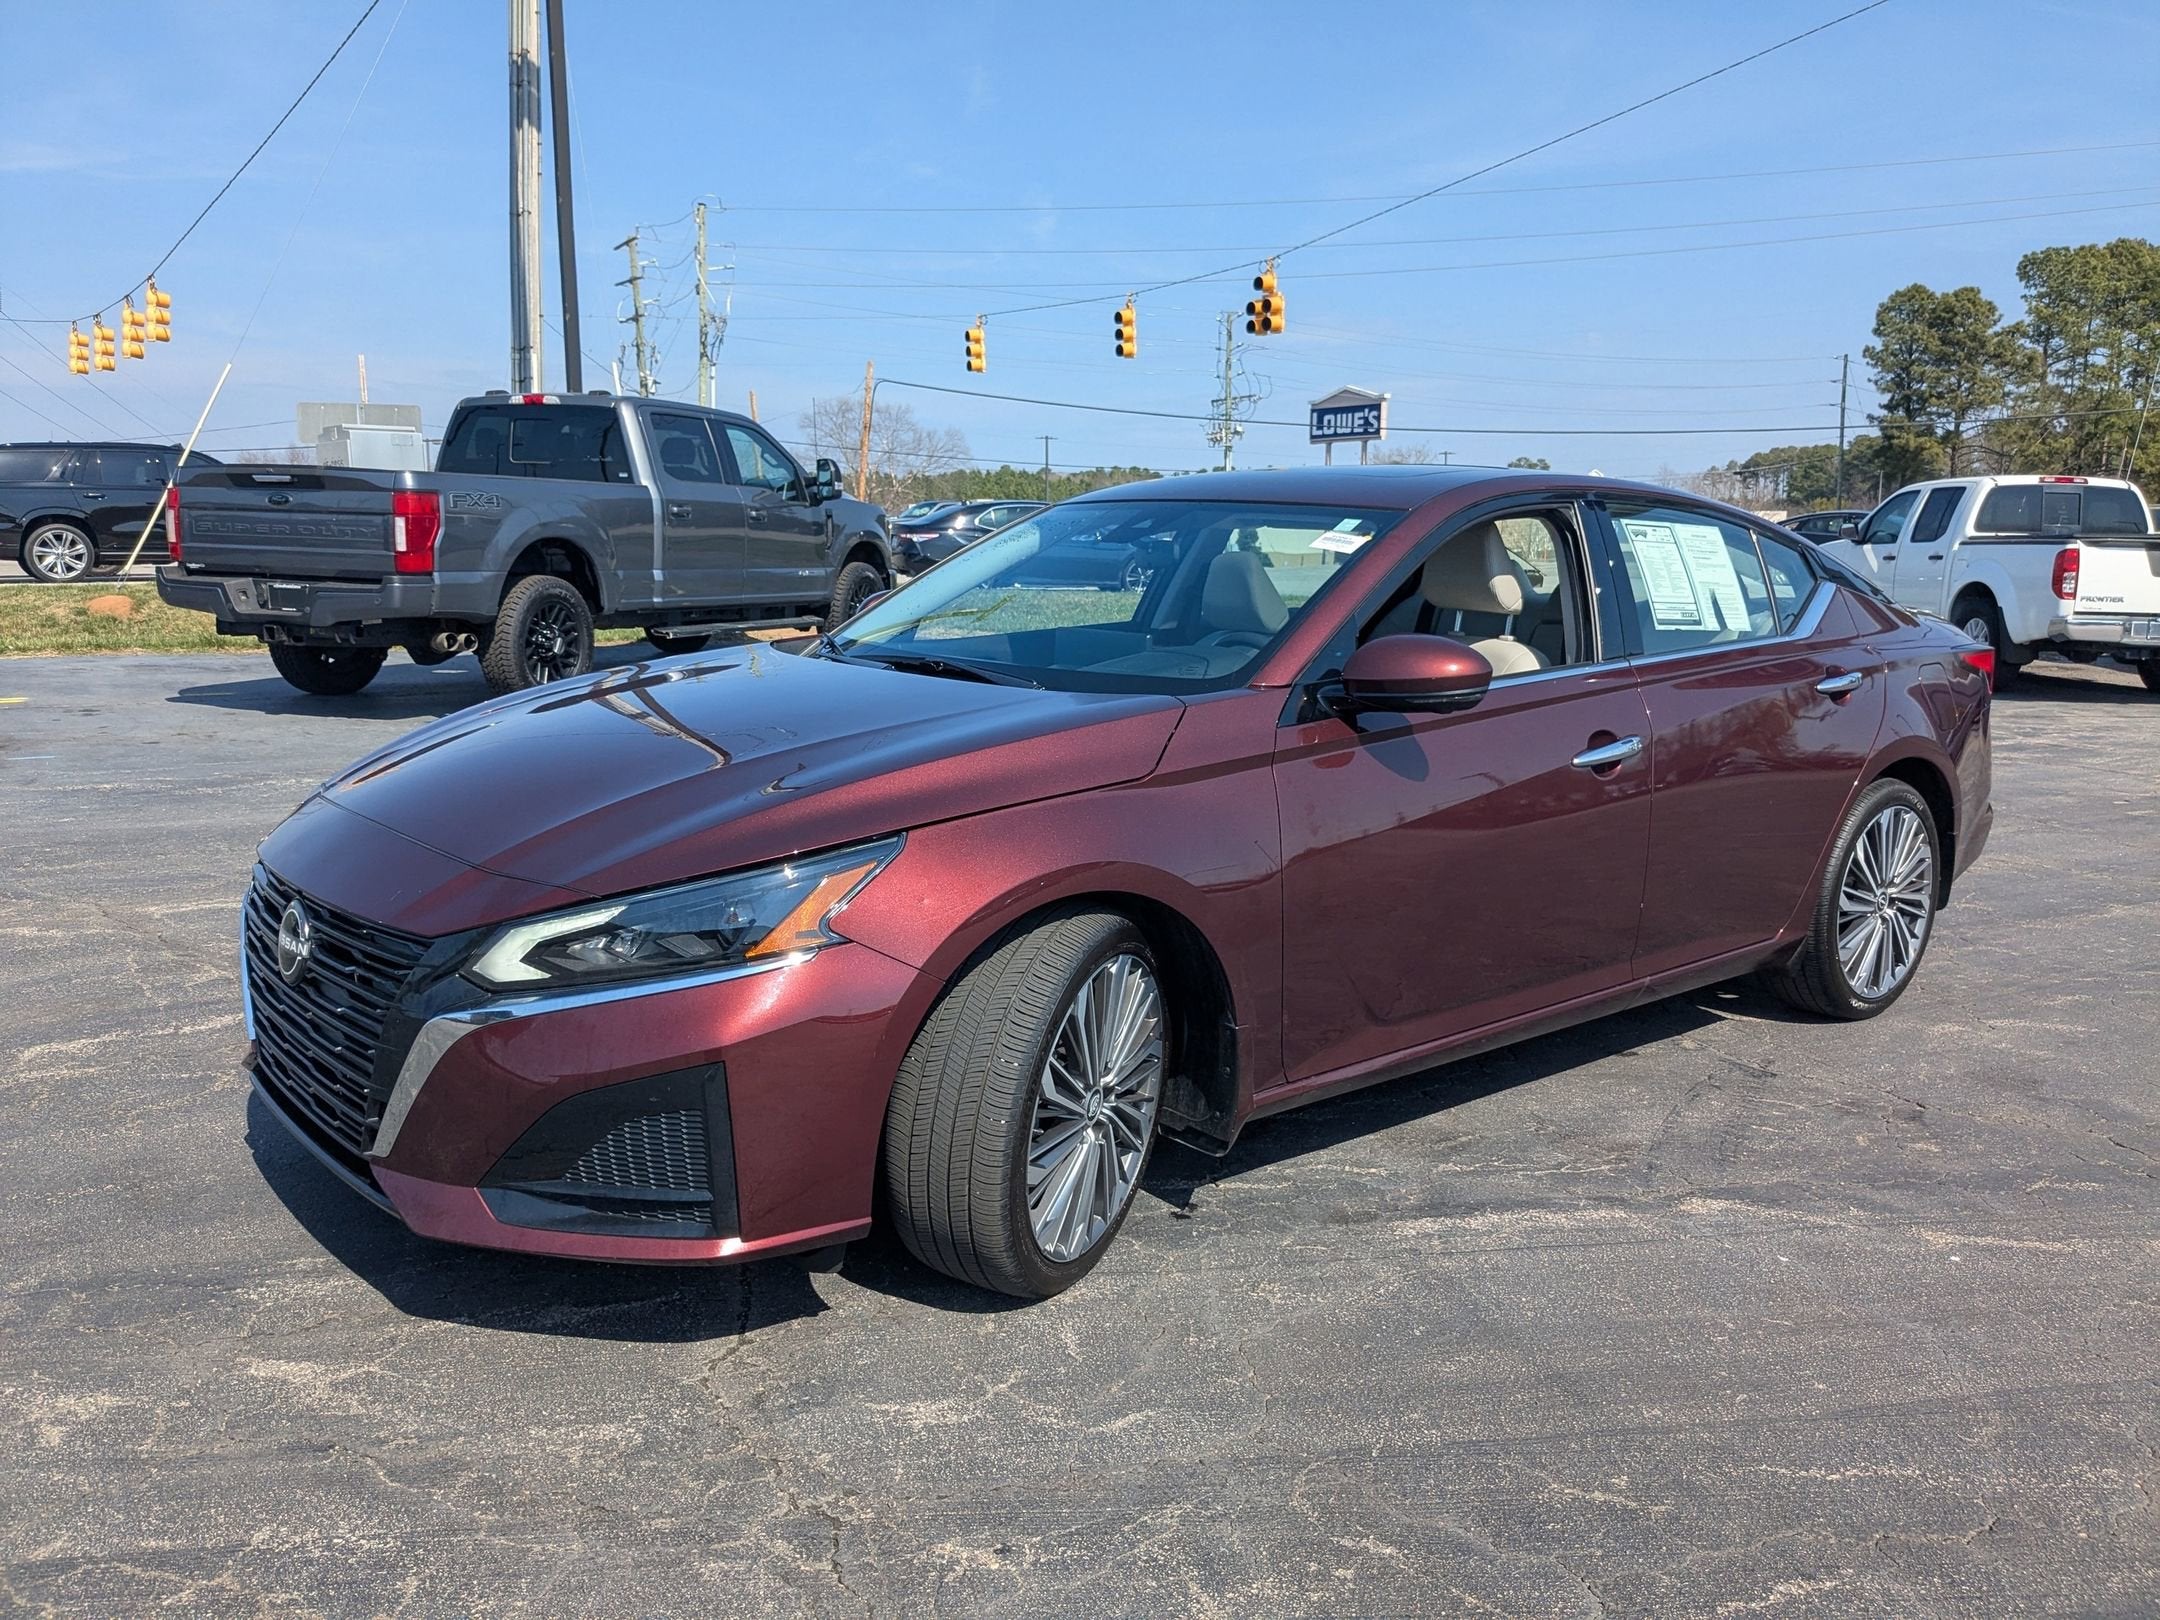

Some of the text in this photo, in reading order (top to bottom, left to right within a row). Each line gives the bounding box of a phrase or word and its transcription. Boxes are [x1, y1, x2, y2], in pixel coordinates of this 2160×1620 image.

[1311, 408, 1379, 436] LOWE'S
[449, 491, 501, 509] FX4
[195, 521, 377, 538] SUPER DUTY
[2080, 595, 2125, 603] FRONTIER
